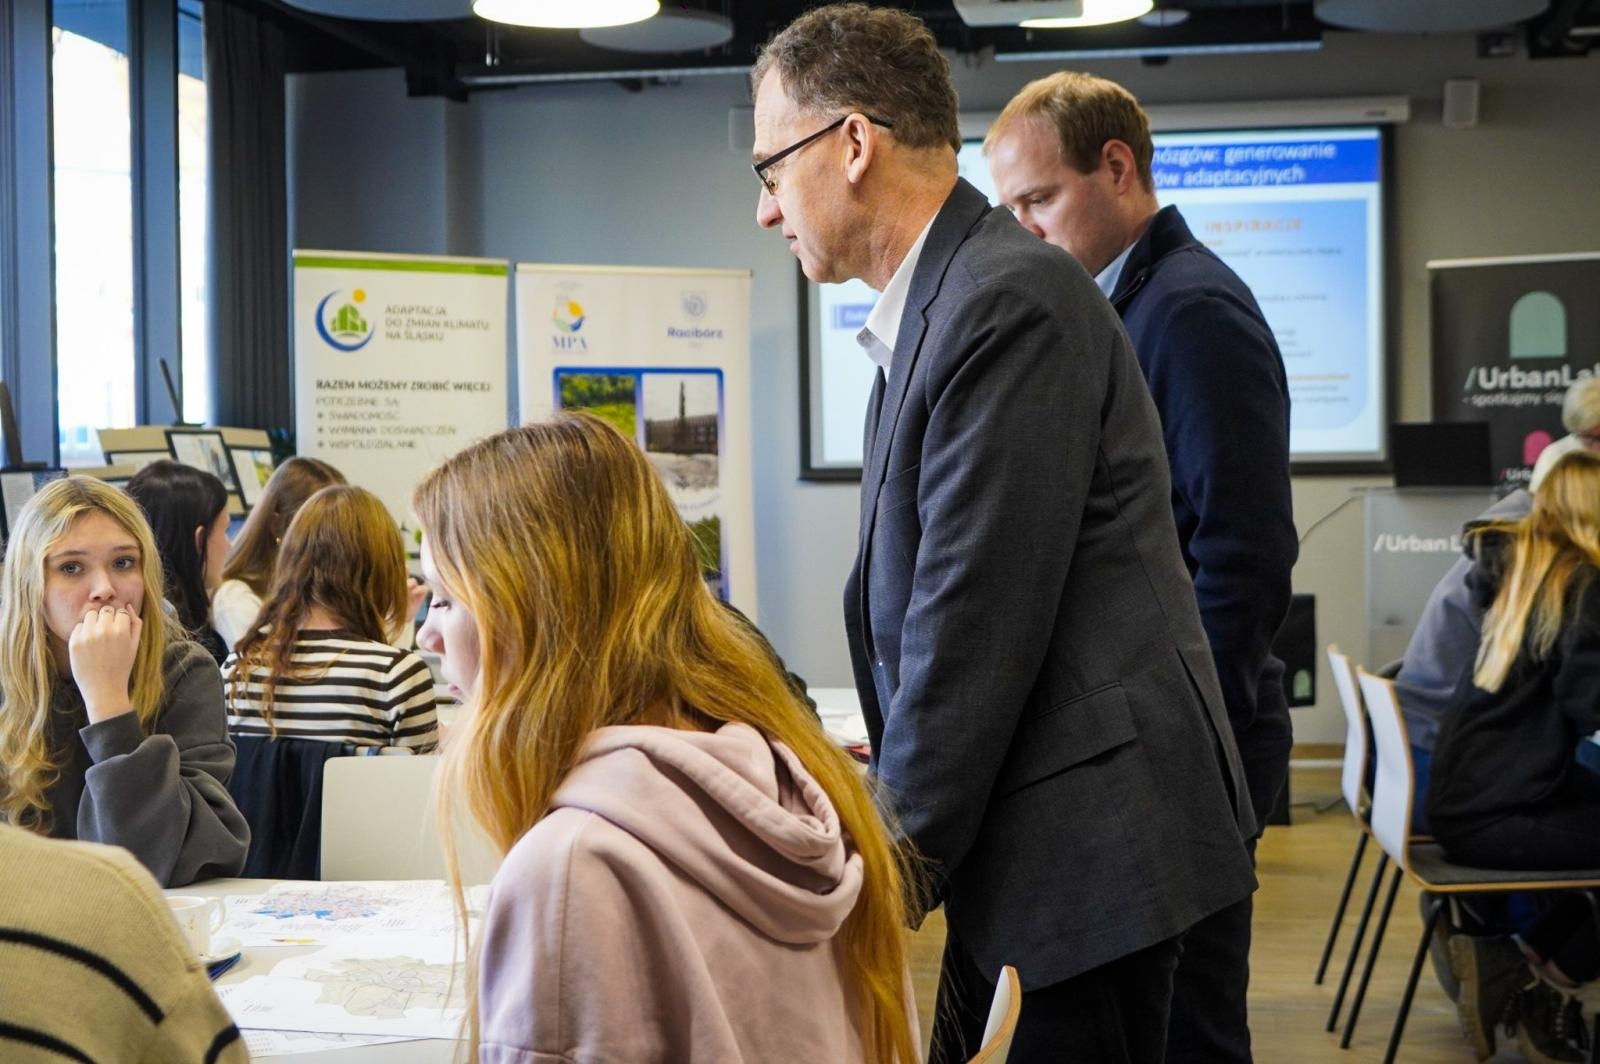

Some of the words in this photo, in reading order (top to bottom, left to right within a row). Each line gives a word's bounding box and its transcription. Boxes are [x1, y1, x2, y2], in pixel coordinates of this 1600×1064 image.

[1224, 141, 1336, 164] generowanie
[1153, 170, 1179, 187] ów
[1183, 163, 1306, 187] adaptacyjnych
[385, 304, 446, 316] ADAPTACJA
[385, 317, 402, 328] DO
[405, 318, 440, 329] ZMIAN
[443, 319, 490, 331] KLIMATU
[385, 331, 401, 341] NA
[667, 326, 723, 339] Racibórz
[552, 335, 588, 350] MPA
[316, 380, 355, 391] RAZEM
[357, 379, 408, 391] MOŻEMY
[410, 379, 450, 391] ZROBIĆ
[453, 381, 491, 393] WIĘCEJ
